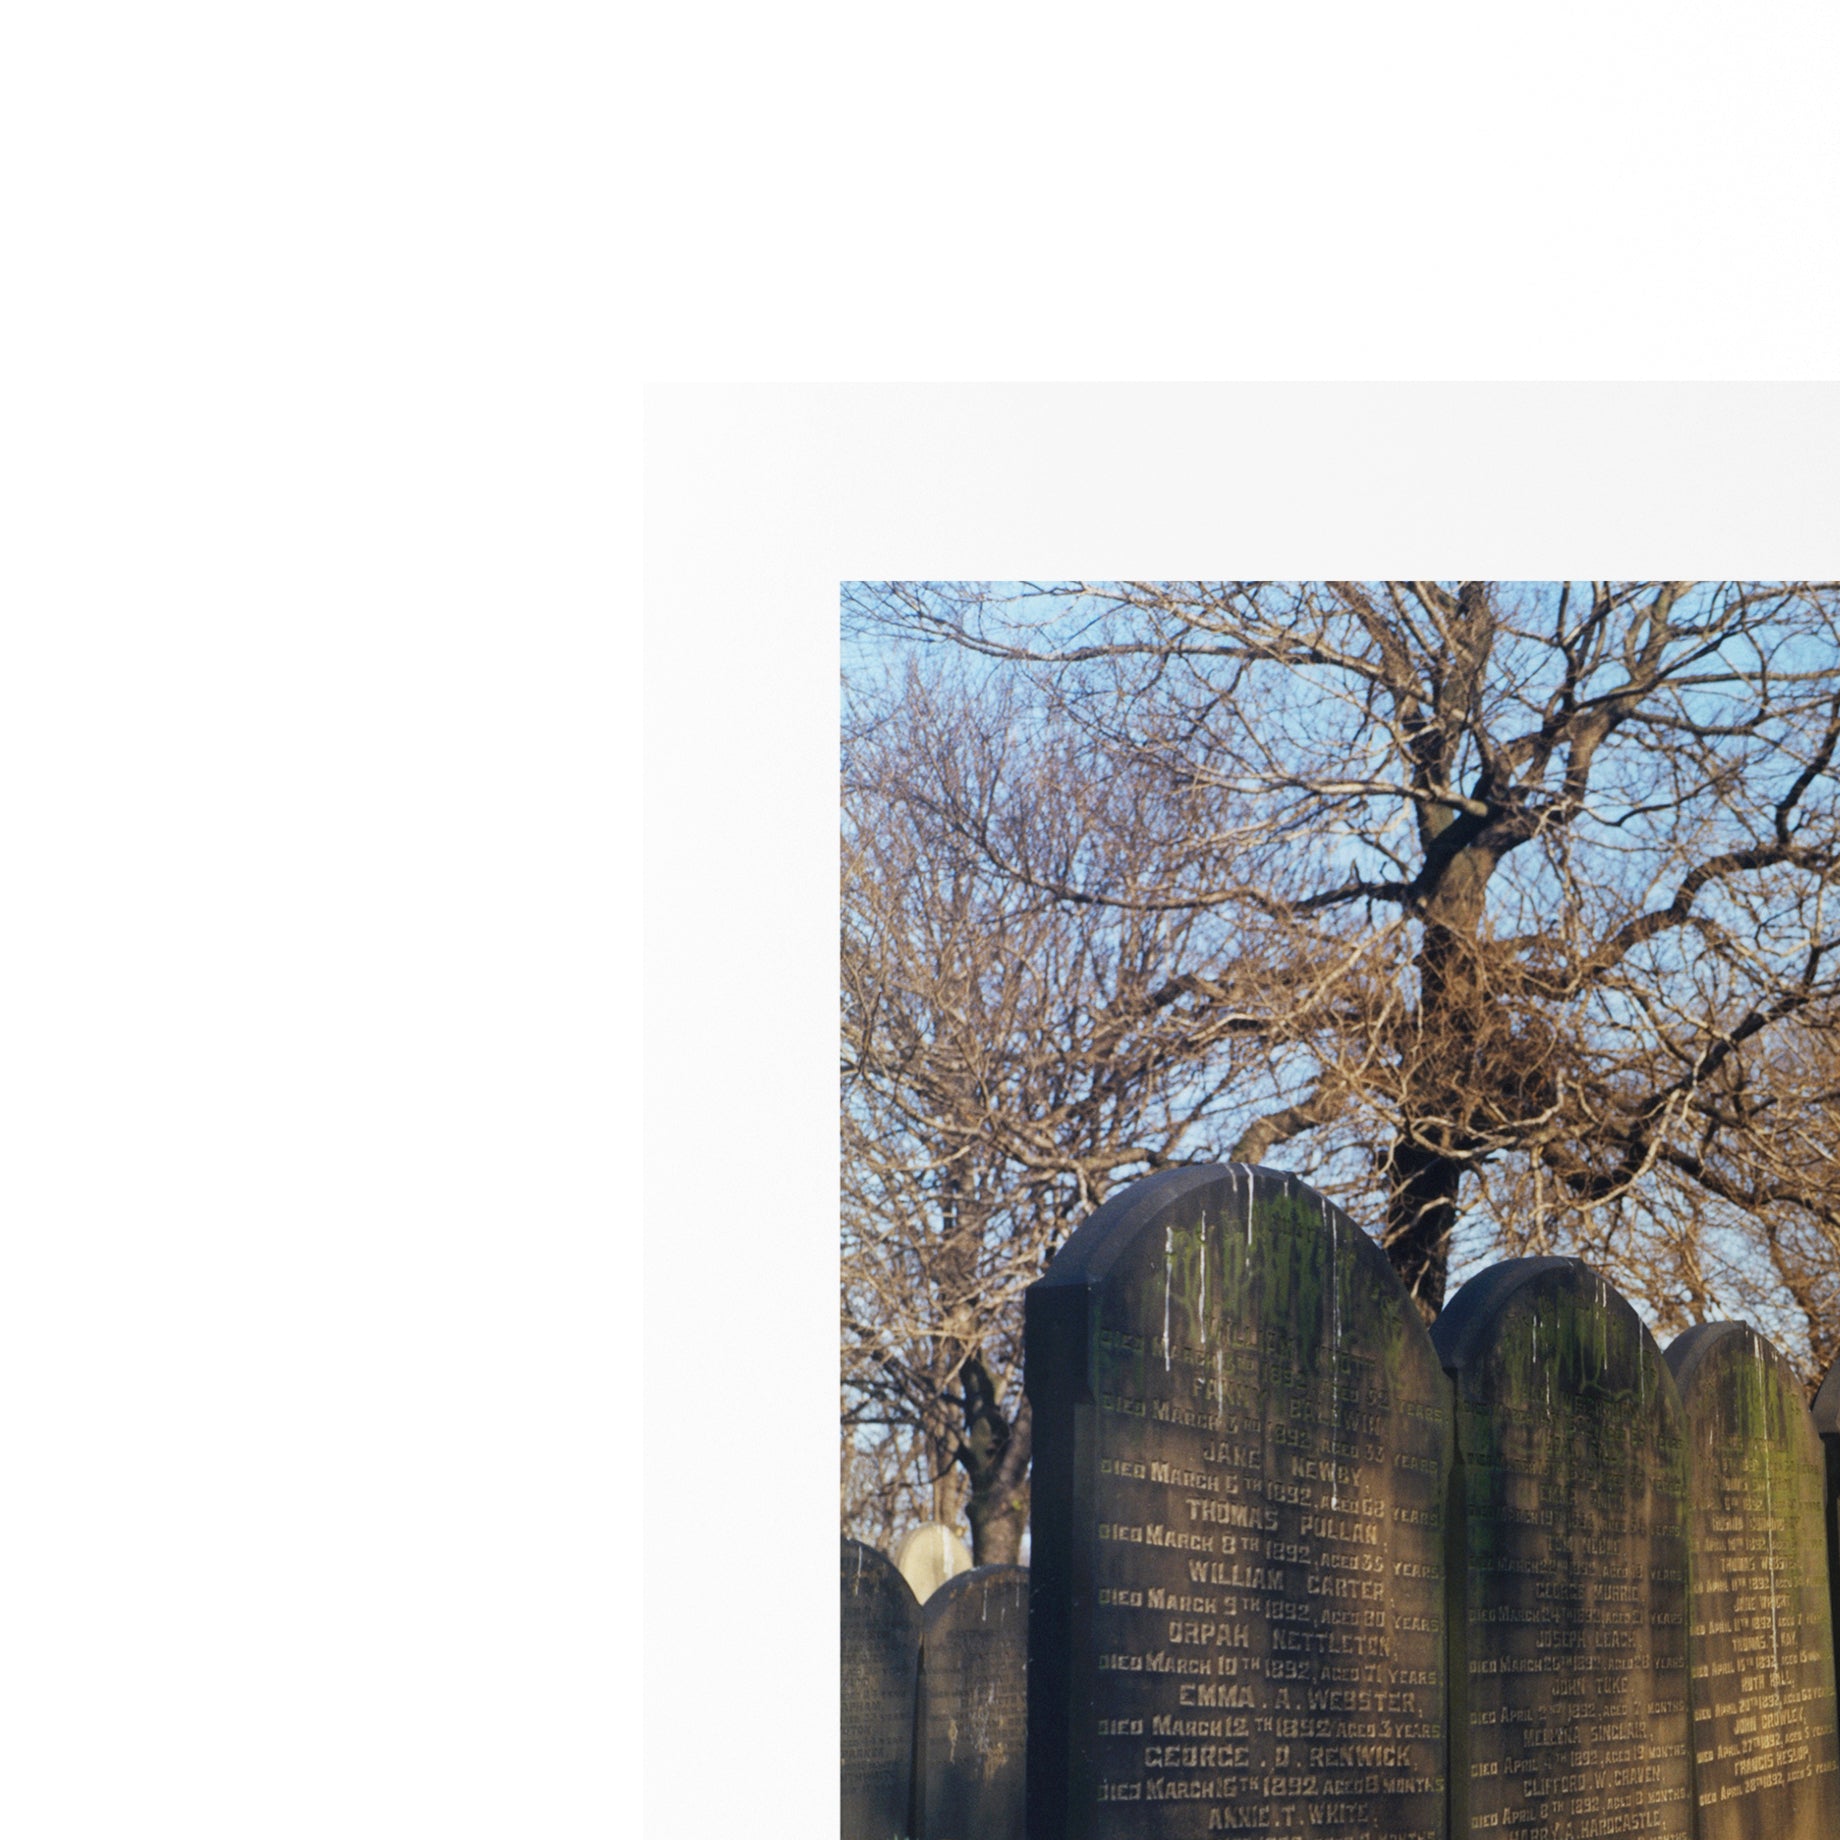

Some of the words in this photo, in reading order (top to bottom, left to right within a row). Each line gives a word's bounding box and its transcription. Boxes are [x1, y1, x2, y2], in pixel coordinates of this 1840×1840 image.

[1203, 1441, 1262, 1470] JANE
[1101, 1458, 1147, 1480] DIED
[1150, 1460, 1220, 1493] MARCH
[1186, 1497, 1280, 1532] THOMAS
[1099, 1523, 1143, 1543] DIED
[1146, 1523, 1213, 1553] MARCH
[1320, 1552, 1360, 1571] AGED
[1188, 1558, 1285, 1592] WILLIAM
[1099, 1587, 1143, 1607] DIED
[1147, 1587, 1217, 1615] MARCH
[1320, 1608, 1360, 1627] AGED
[1168, 1620, 1250, 1649] ORPAH
[1535, 1629, 1587, 1649] JOSEPH
[1099, 1653, 1143, 1672] DIED
[1145, 1650, 1212, 1676] MARCH
[1320, 1665, 1360, 1683] AGED
[1469, 1659, 1497, 1674] DIED
[1499, 1655, 1543, 1673] MARCH
[1551, 1676, 1586, 1696] JOHN
[1097, 1717, 1143, 1736] DIED
[1151, 1714, 1224, 1738] MARCH
[1275, 1717, 1331, 1740] 1892
[1335, 1720, 1377, 1739] AGED
[1378, 1720, 1393, 1738] 3
[1469, 1710, 1497, 1726] DIED
[1500, 1705, 1534, 1724] APRIL
[1470, 1761, 1498, 1778] DIED
[1503, 1756, 1539, 1775] APRIL
[1096, 1779, 1142, 1801] DIED
[1145, 1777, 1214, 1801] MARCH
[1262, 1774, 1319, 1798] 1892
[1322, 1778, 1364, 1796] AGED
[1471, 1812, 1499, 1830] DIED
[1501, 1806, 1537, 1825] APRIL
